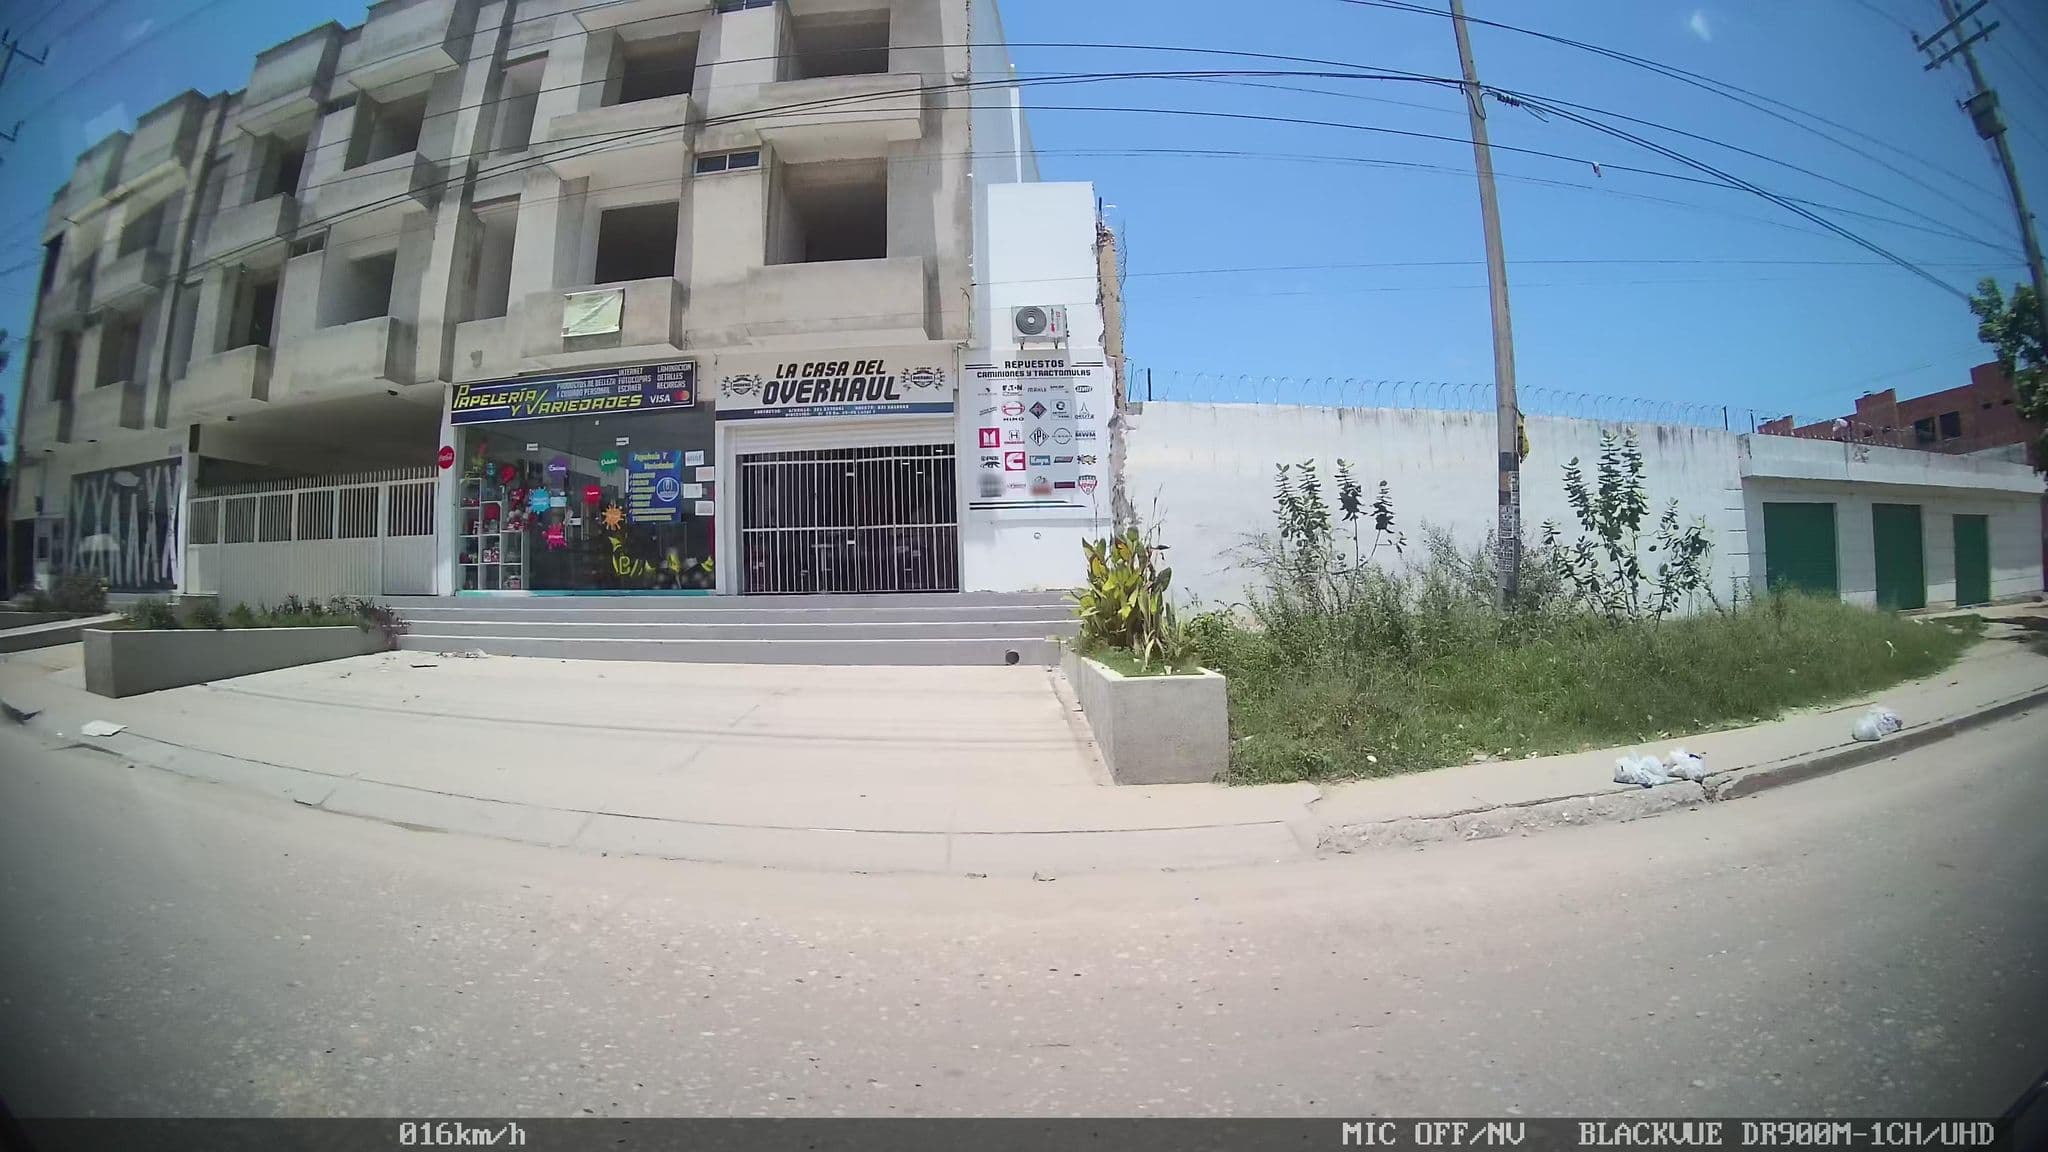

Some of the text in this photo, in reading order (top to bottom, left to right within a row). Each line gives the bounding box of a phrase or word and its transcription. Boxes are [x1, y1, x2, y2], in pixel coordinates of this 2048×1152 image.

[776, 360, 886, 379] LA CASA DEL
[1004, 360, 1064, 369] REPUESTOS
[1026, 369, 1032, 377] Y
[1034, 369, 1091, 377] TRACTOMULAS
[762, 376, 900, 405] OVERHAUL
[511, 389, 643, 417] Y VARIEDADES
[649, 394, 671, 404] VISA
